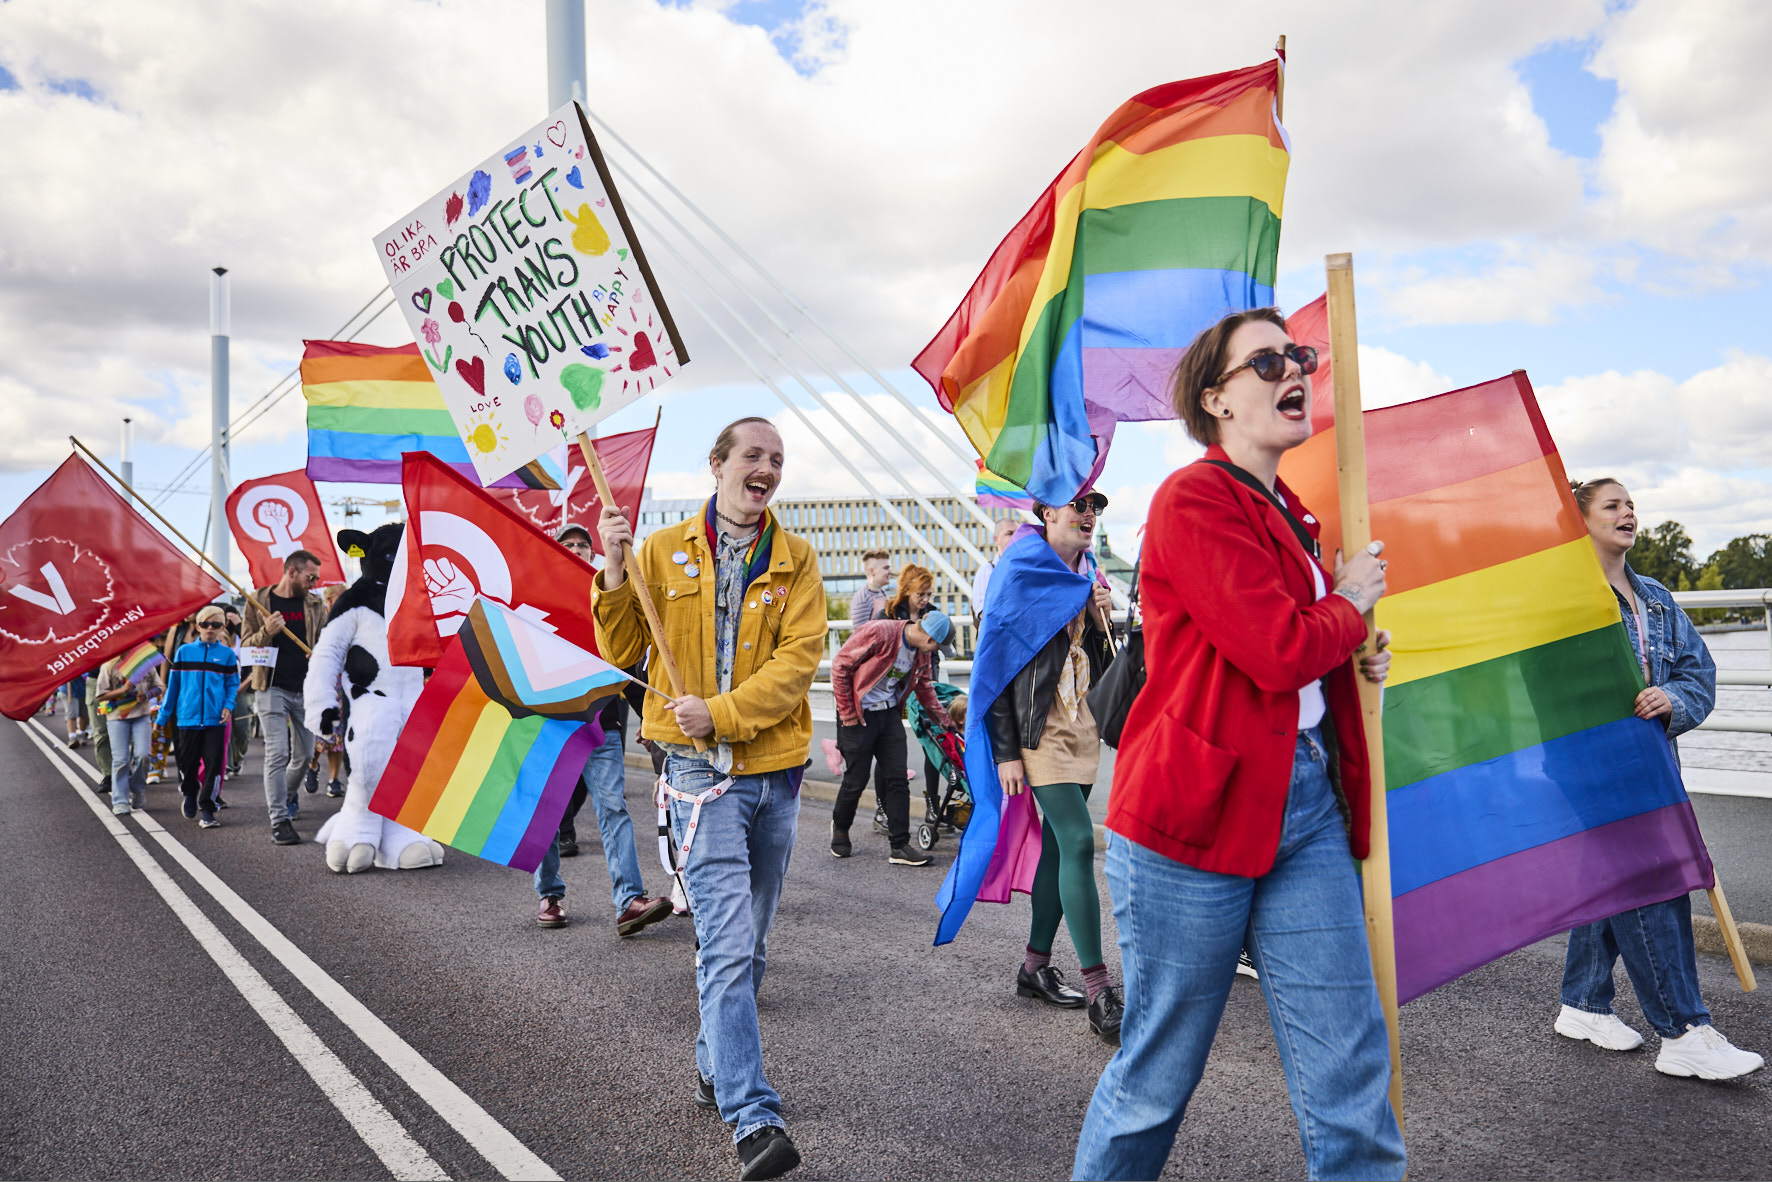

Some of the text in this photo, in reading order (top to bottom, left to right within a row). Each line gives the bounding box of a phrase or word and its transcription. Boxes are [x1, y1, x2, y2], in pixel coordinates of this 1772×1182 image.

[385, 220, 427, 257] OLIKA
[440, 167, 563, 291] PROTECT
[390, 234, 438, 279] ÄR BRA
[474, 238, 579, 328] TRANS
[592, 284, 608, 302] BI
[601, 267, 629, 328] HAPPY
[502, 290, 604, 380] YOUTH
[470, 396, 502, 413] LOVE
